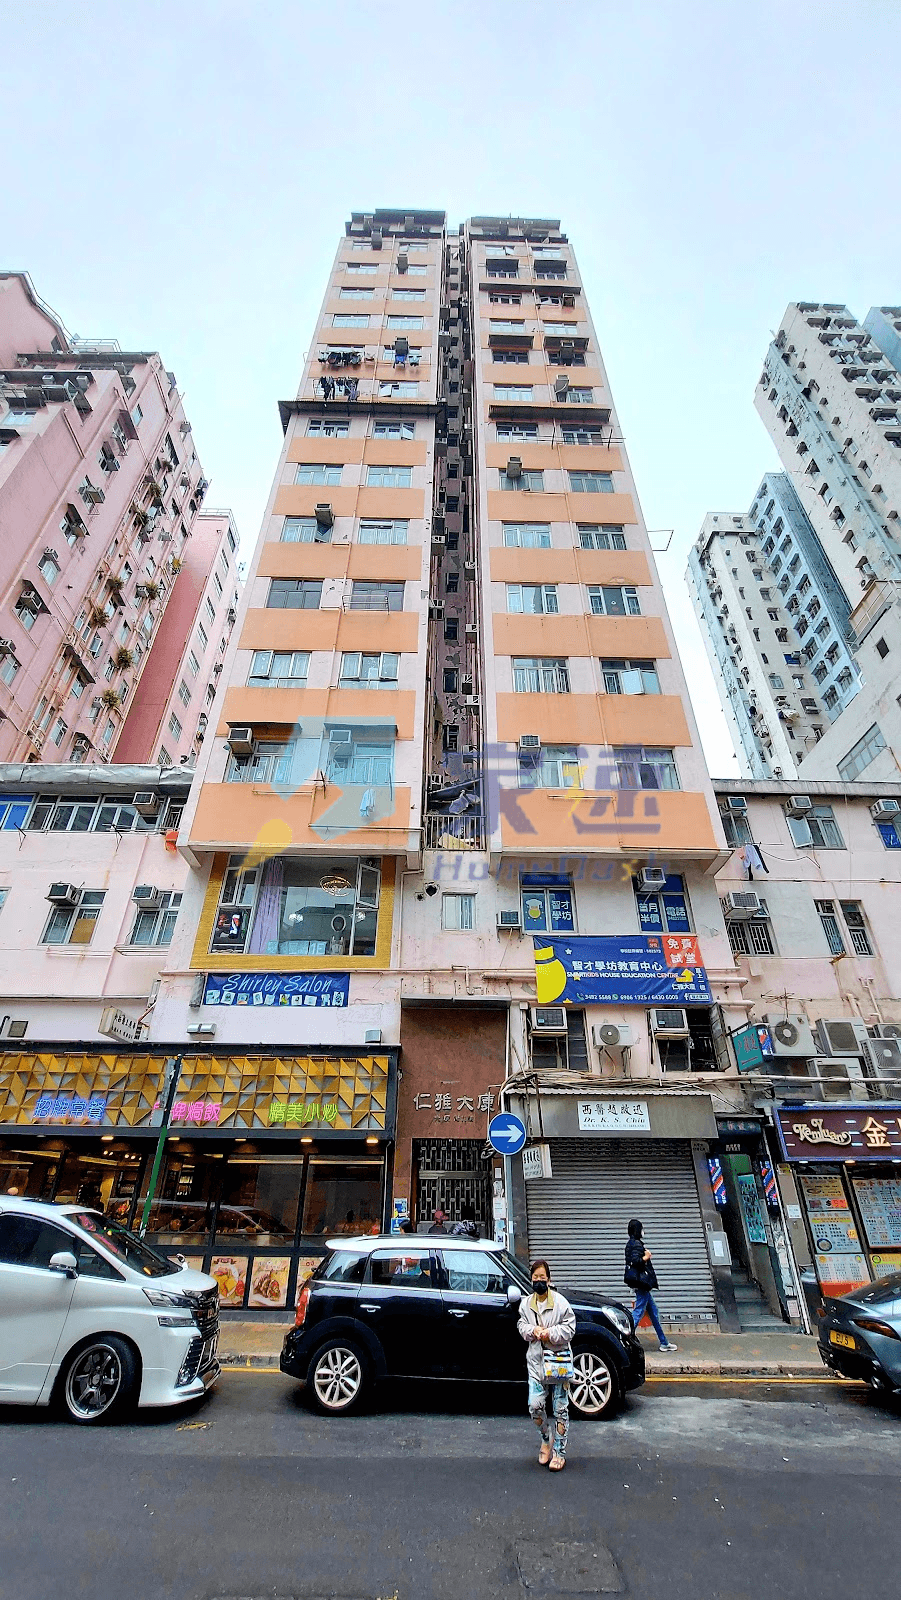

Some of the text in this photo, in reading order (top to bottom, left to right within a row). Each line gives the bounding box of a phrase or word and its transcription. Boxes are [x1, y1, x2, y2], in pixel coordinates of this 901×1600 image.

[667, 938, 693, 949] 免費
[571, 960, 663, 971] 智才學坊教育中心
[670, 952, 697, 964] 試堂
[222, 974, 333, 996] Shirley Salon
[33, 1098, 106, 1120] 招牌常餐
[151, 1101, 221, 1121] 牌焗飯
[268, 1102, 339, 1122] 精美小炒
[413, 1092, 495, 1112] 仁雅大廈
